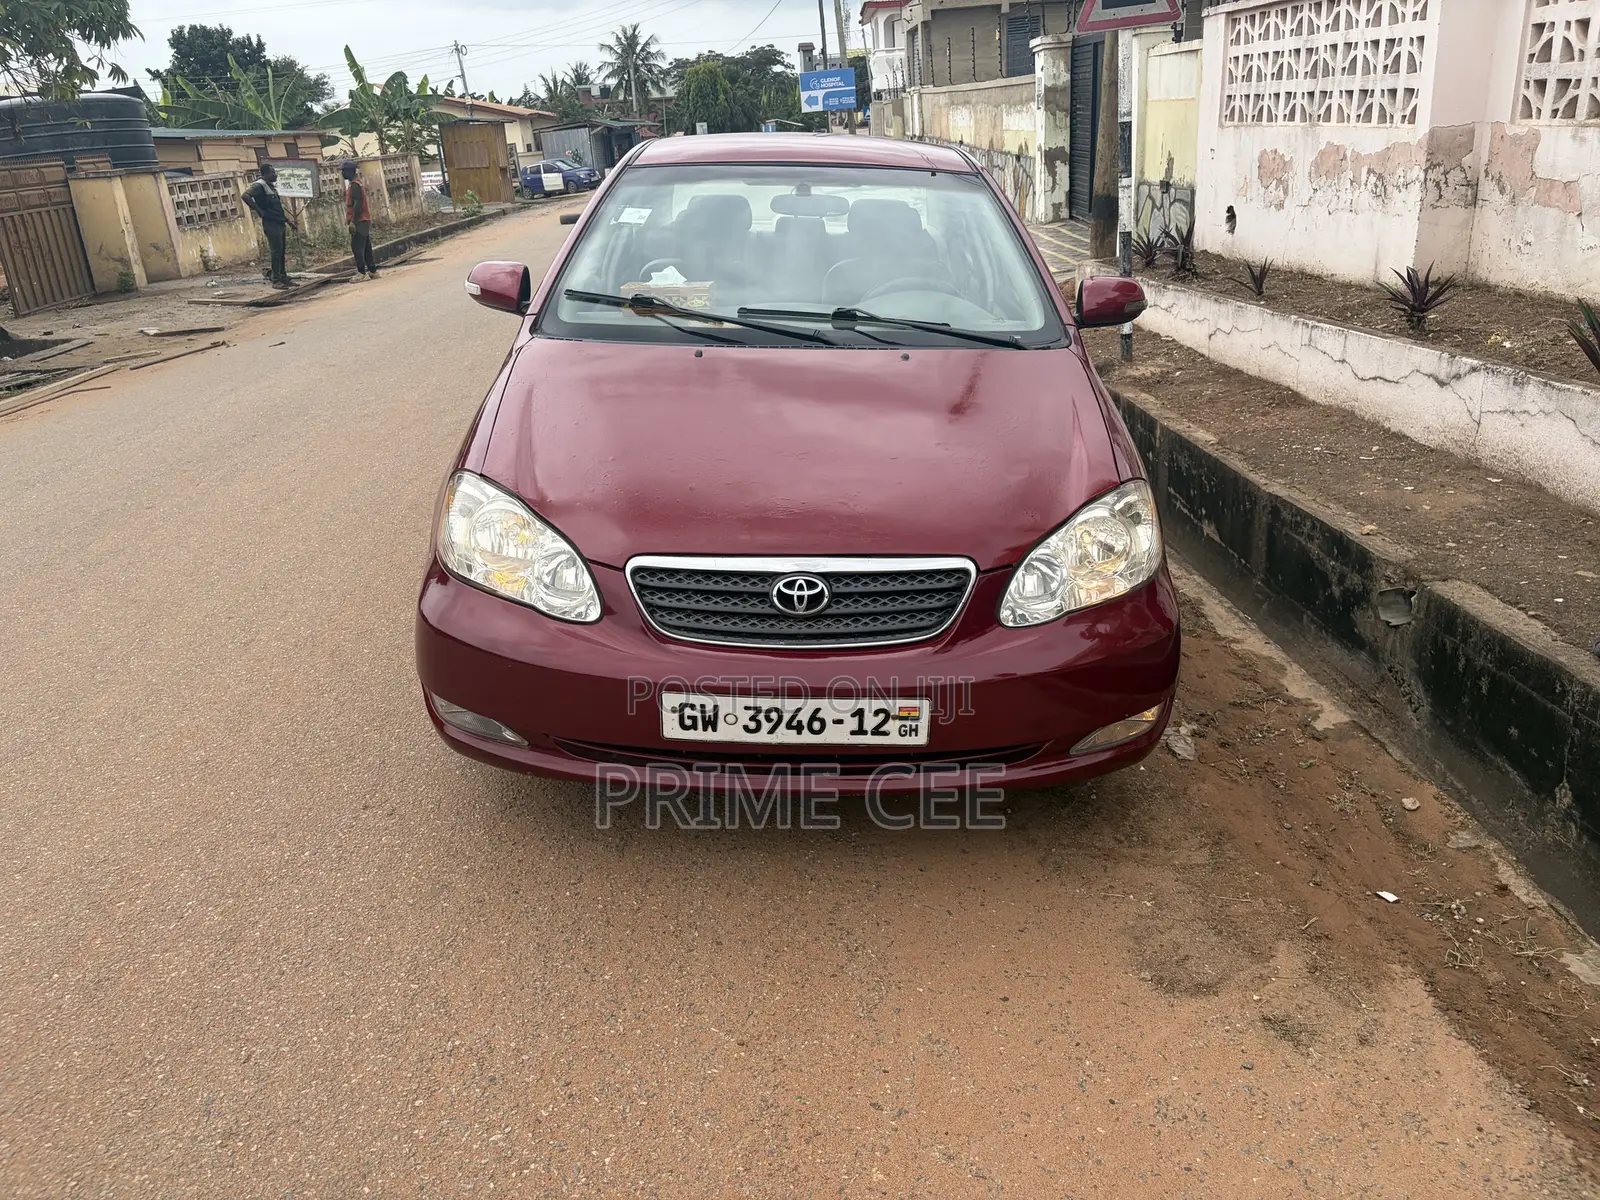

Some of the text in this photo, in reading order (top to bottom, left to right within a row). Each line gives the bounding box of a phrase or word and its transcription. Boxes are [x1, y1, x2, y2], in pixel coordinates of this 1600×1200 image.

[678, 702, 891, 736] GW 3946-12
[898, 724, 919, 737] GH
